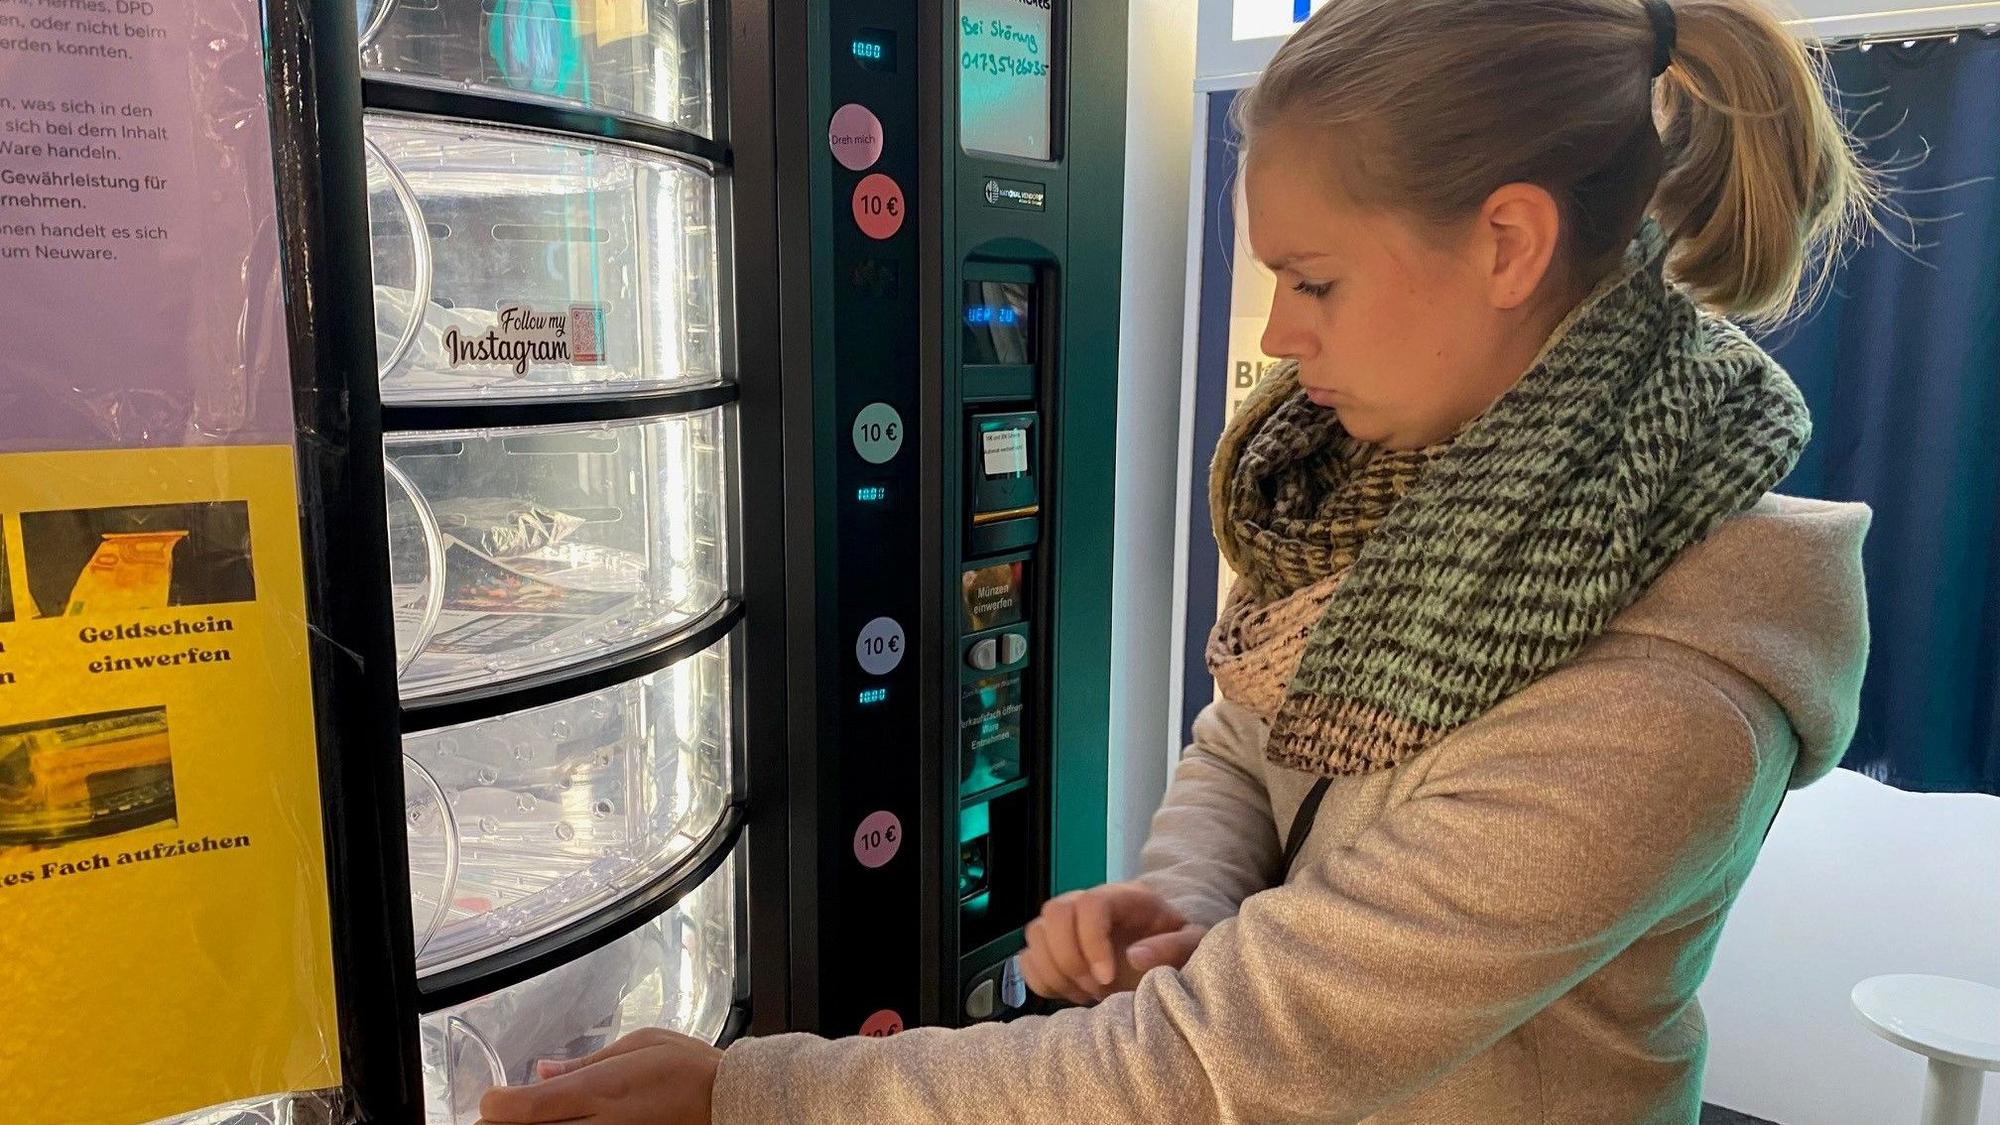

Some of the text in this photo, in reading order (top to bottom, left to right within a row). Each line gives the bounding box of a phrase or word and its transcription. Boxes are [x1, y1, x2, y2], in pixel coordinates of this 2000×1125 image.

[116, 0, 154, 16] DPD
[30, 17, 71, 31] oder
[76, 20, 120, 36] nicht
[125, 23, 167, 39] beim
[961, 15, 1038, 54] Bei Störung
[0, 37, 133, 60] erden konnten.
[20, 98, 56, 112] was
[61, 99, 95, 114] sich
[101, 101, 116, 116] in
[121, 103, 153, 117] den
[5, 118, 168, 141] sich bei dem Inhalt
[832, 134, 876, 145] Dreh mich
[47, 143, 121, 161] handeln.
[1, 169, 167, 193] Gewährleistung für
[0, 193, 87, 209] rnehmen.
[861, 194, 899, 216] 10 €
[41, 223, 106, 238] handelt
[112, 228, 130, 240] es
[135, 226, 168, 240] sich
[1, 244, 118, 260] um Neuware.
[501, 307, 566, 338] Follow my
[446, 330, 570, 375] Instagram
[861, 422, 897, 443] 10 €
[977, 584, 1009, 599] Münzen
[973, 597, 1013, 616] einwerfen
[79, 615, 234, 644] Geldschein
[864, 635, 899, 655] 10 €
[88, 648, 231, 674] einwerfen
[861, 825, 897, 850] 10 €
[41, 853, 110, 880] Fach
[116, 834, 250, 866] aufziehen
